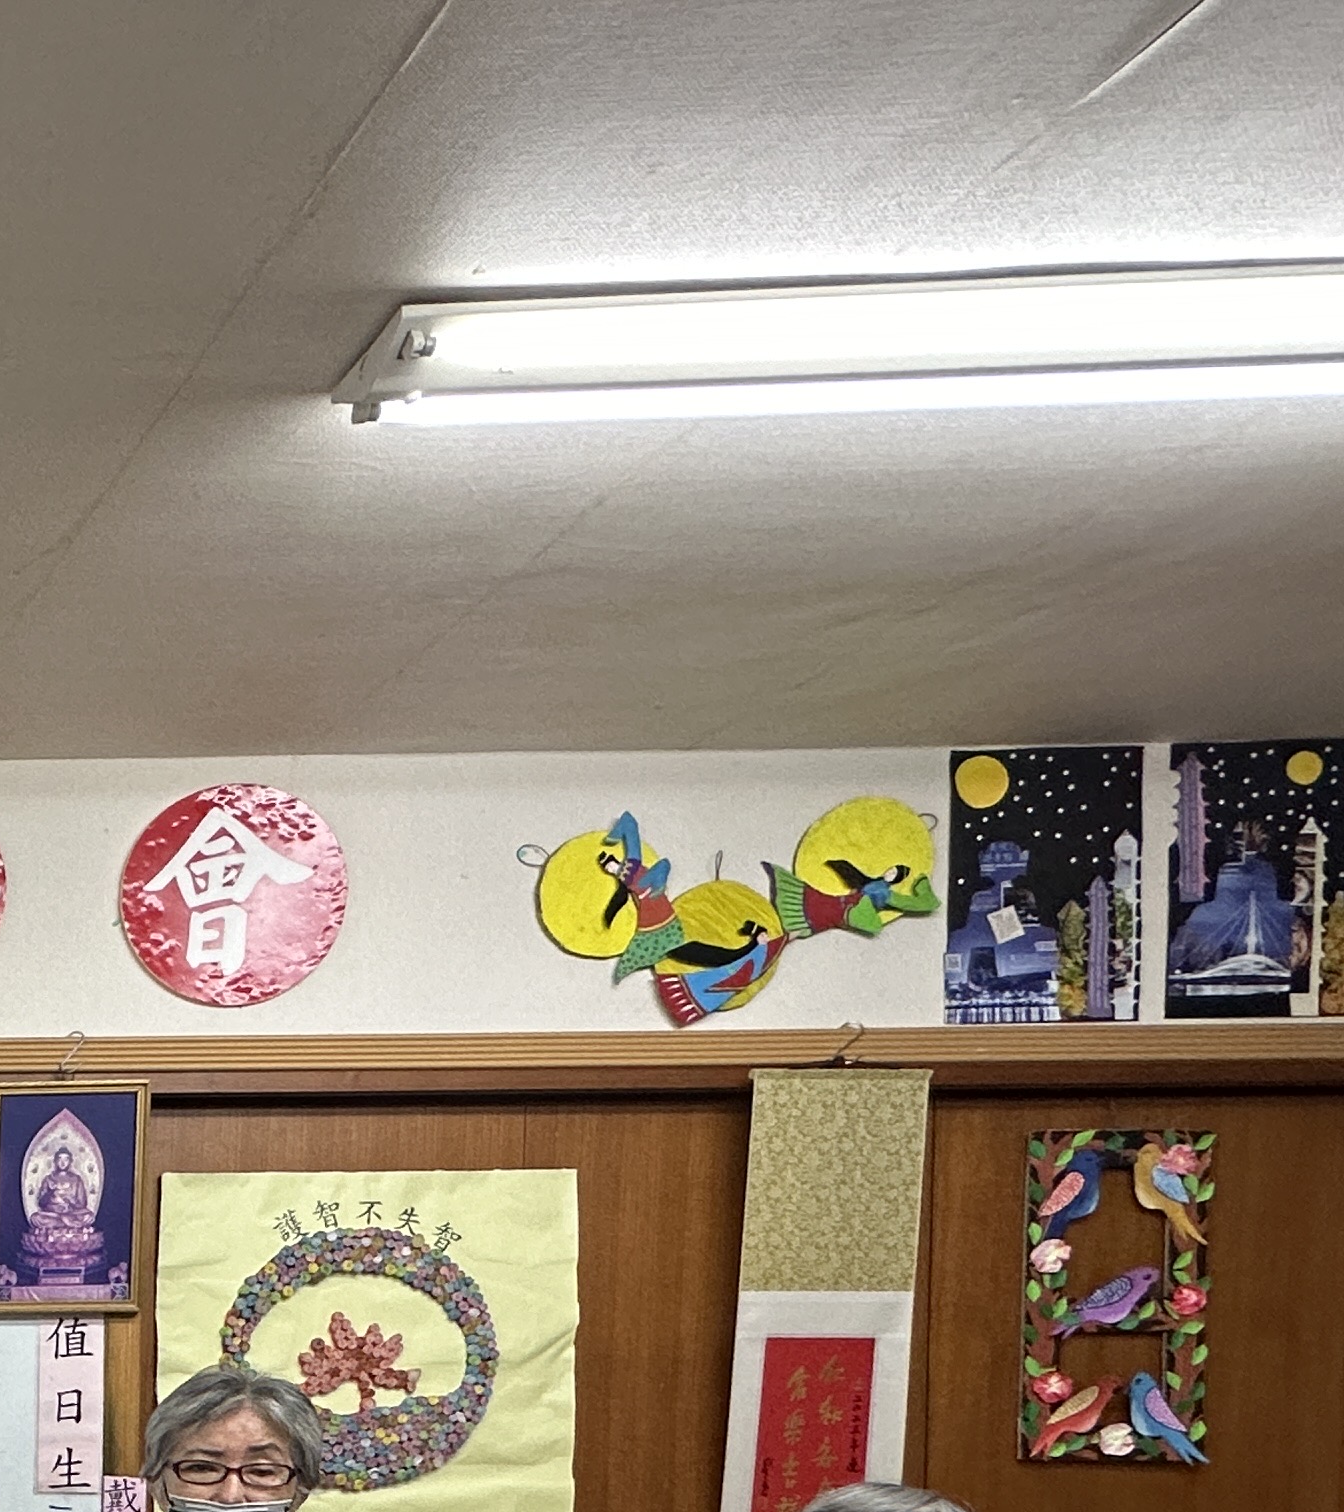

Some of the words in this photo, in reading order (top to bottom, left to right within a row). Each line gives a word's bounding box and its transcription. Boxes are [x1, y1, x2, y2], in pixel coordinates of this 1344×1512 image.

[273, 1200, 462, 1252] 護智不失智
[46, 1318, 93, 1489] 值日生
